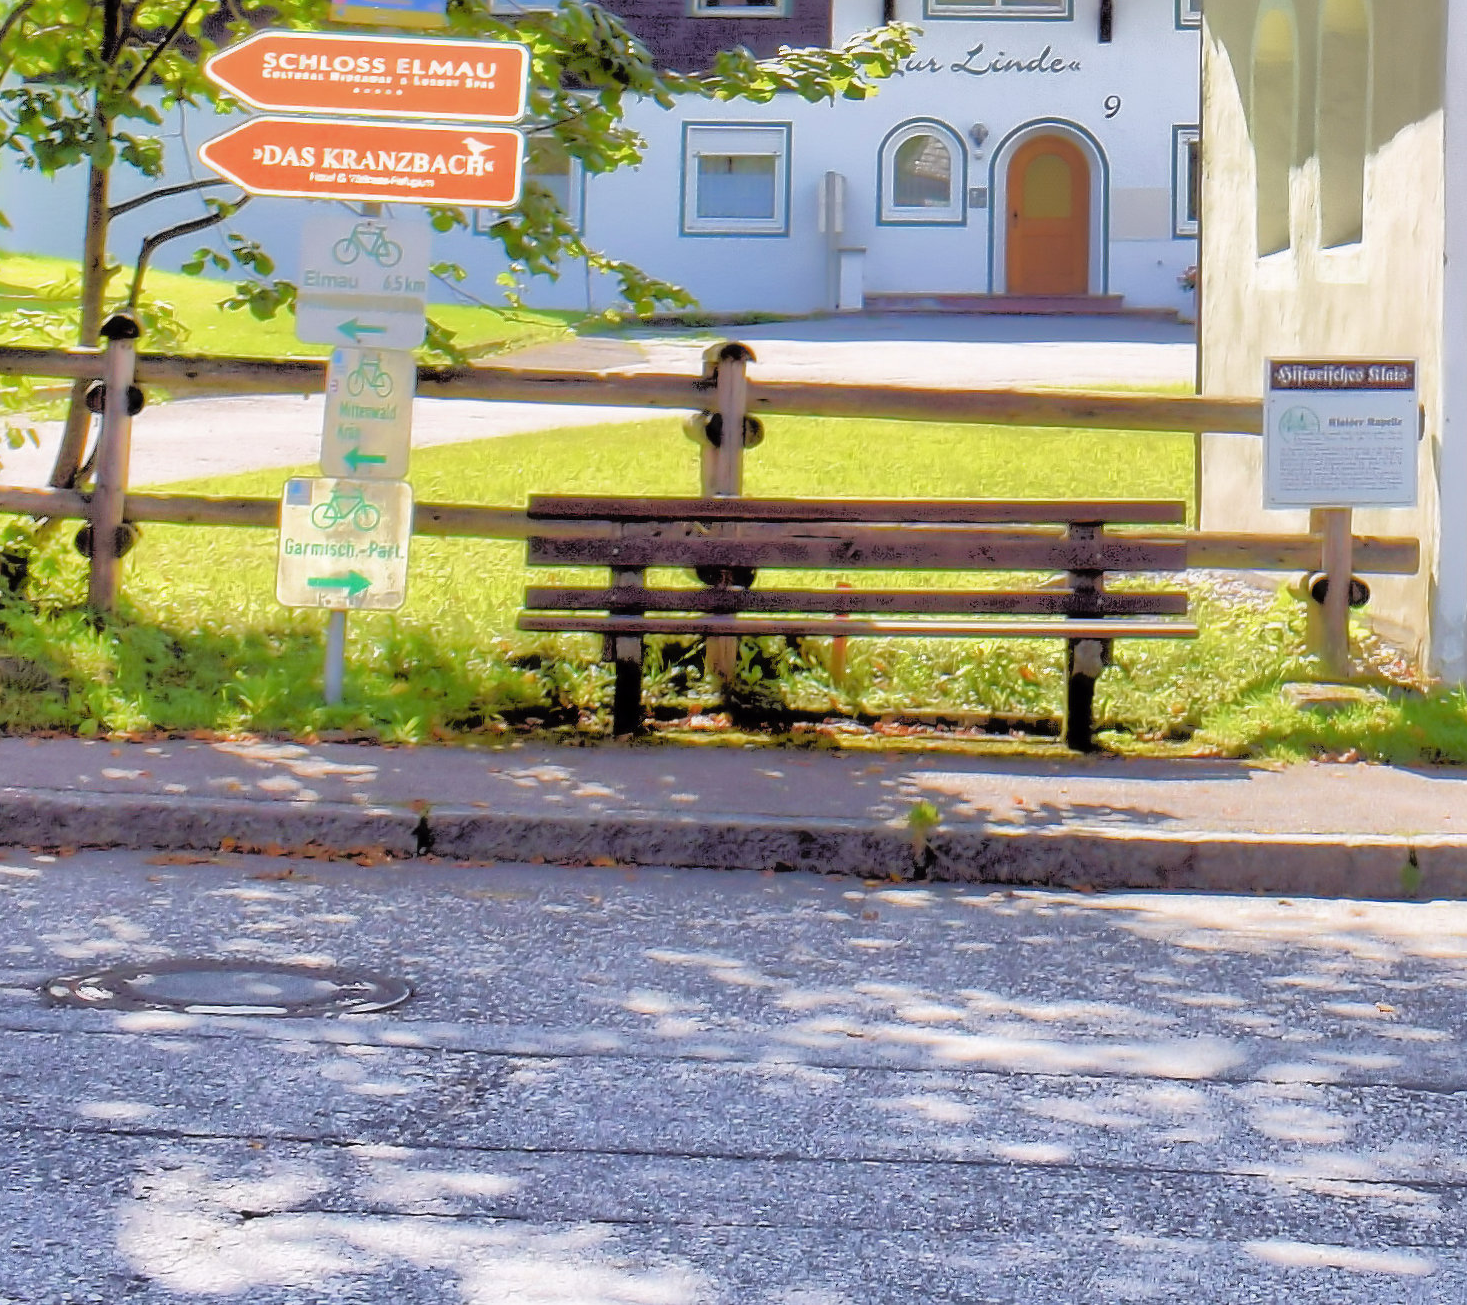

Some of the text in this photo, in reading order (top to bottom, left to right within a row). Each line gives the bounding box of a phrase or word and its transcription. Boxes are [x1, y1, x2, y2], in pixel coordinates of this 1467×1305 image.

[262, 52, 497, 79] SCHLOSS ELMAU
[1103, 95, 1122, 119] 9
[303, 270, 359, 289] Elmau
